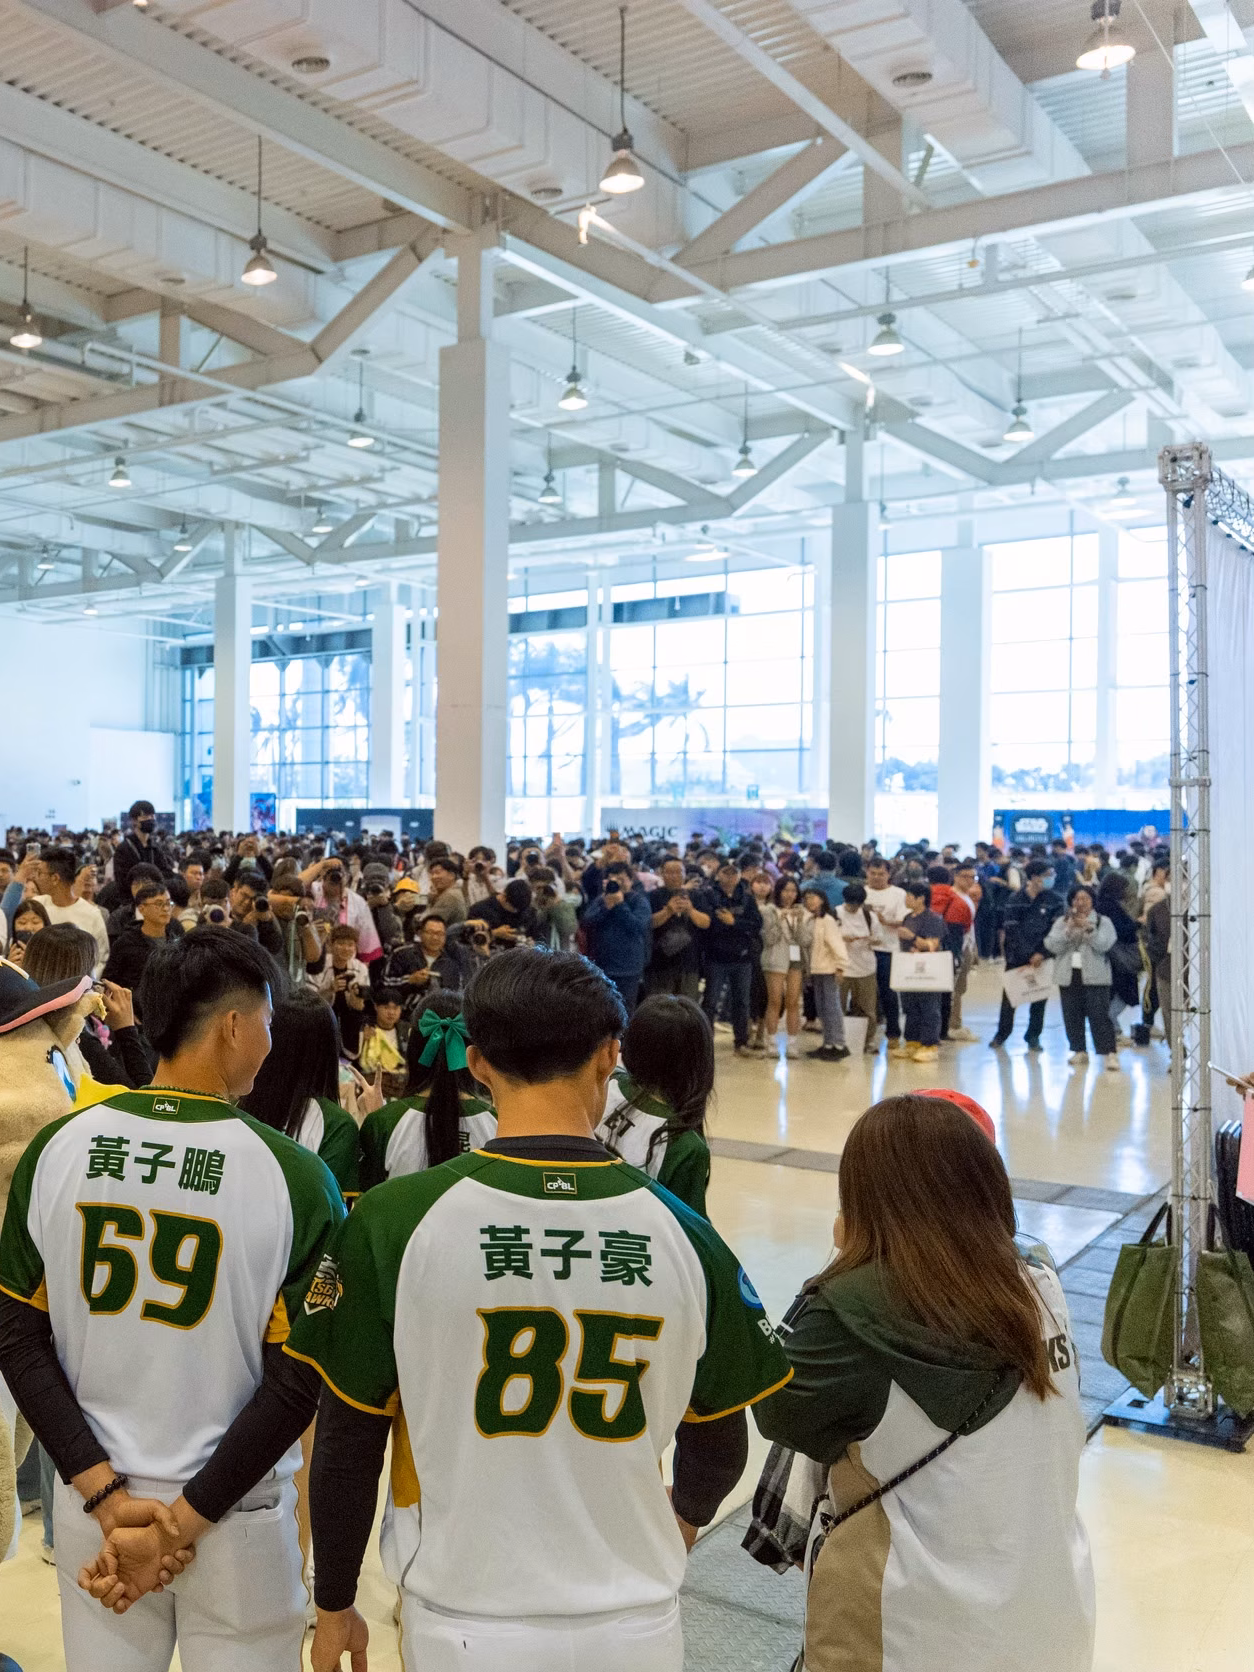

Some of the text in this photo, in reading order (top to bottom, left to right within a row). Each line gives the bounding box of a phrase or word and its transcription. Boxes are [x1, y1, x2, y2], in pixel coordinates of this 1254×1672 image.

[86, 1135, 226, 1196] 黃子鵬
[75, 1202, 224, 1331] 69
[479, 1225, 653, 1287] 黃子豪
[473, 1305, 665, 1442] 85
